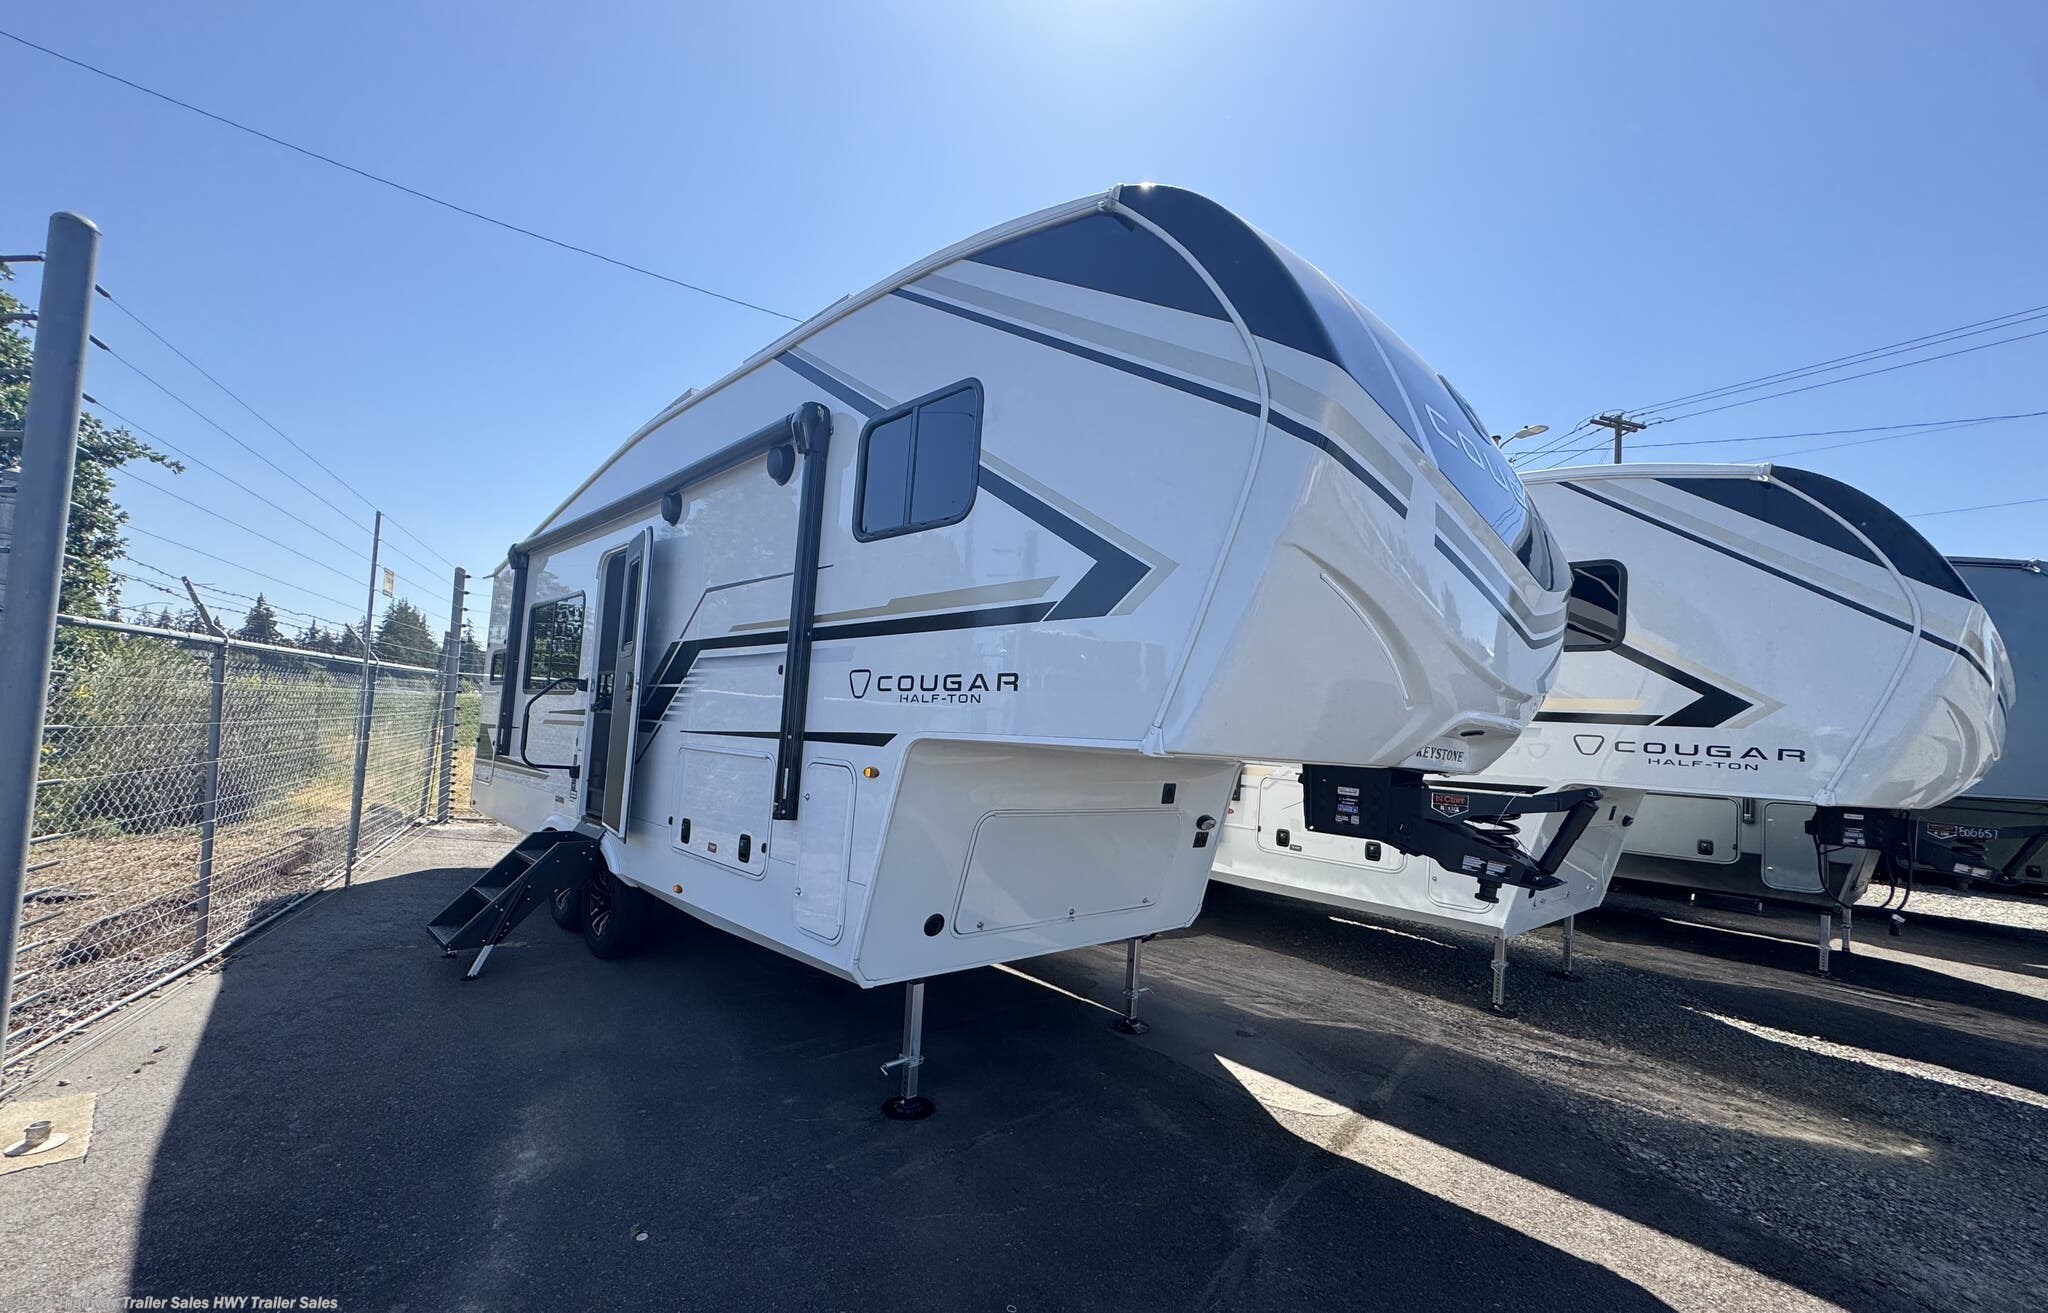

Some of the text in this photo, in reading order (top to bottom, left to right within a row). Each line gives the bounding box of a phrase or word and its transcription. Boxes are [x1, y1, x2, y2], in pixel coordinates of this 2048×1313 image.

[876, 672, 1020, 692] COUGAR
[899, 693, 982, 704] HALF-TON
[1614, 741, 1807, 763] COUGAR
[1647, 757, 1759, 771] HALF-TON
